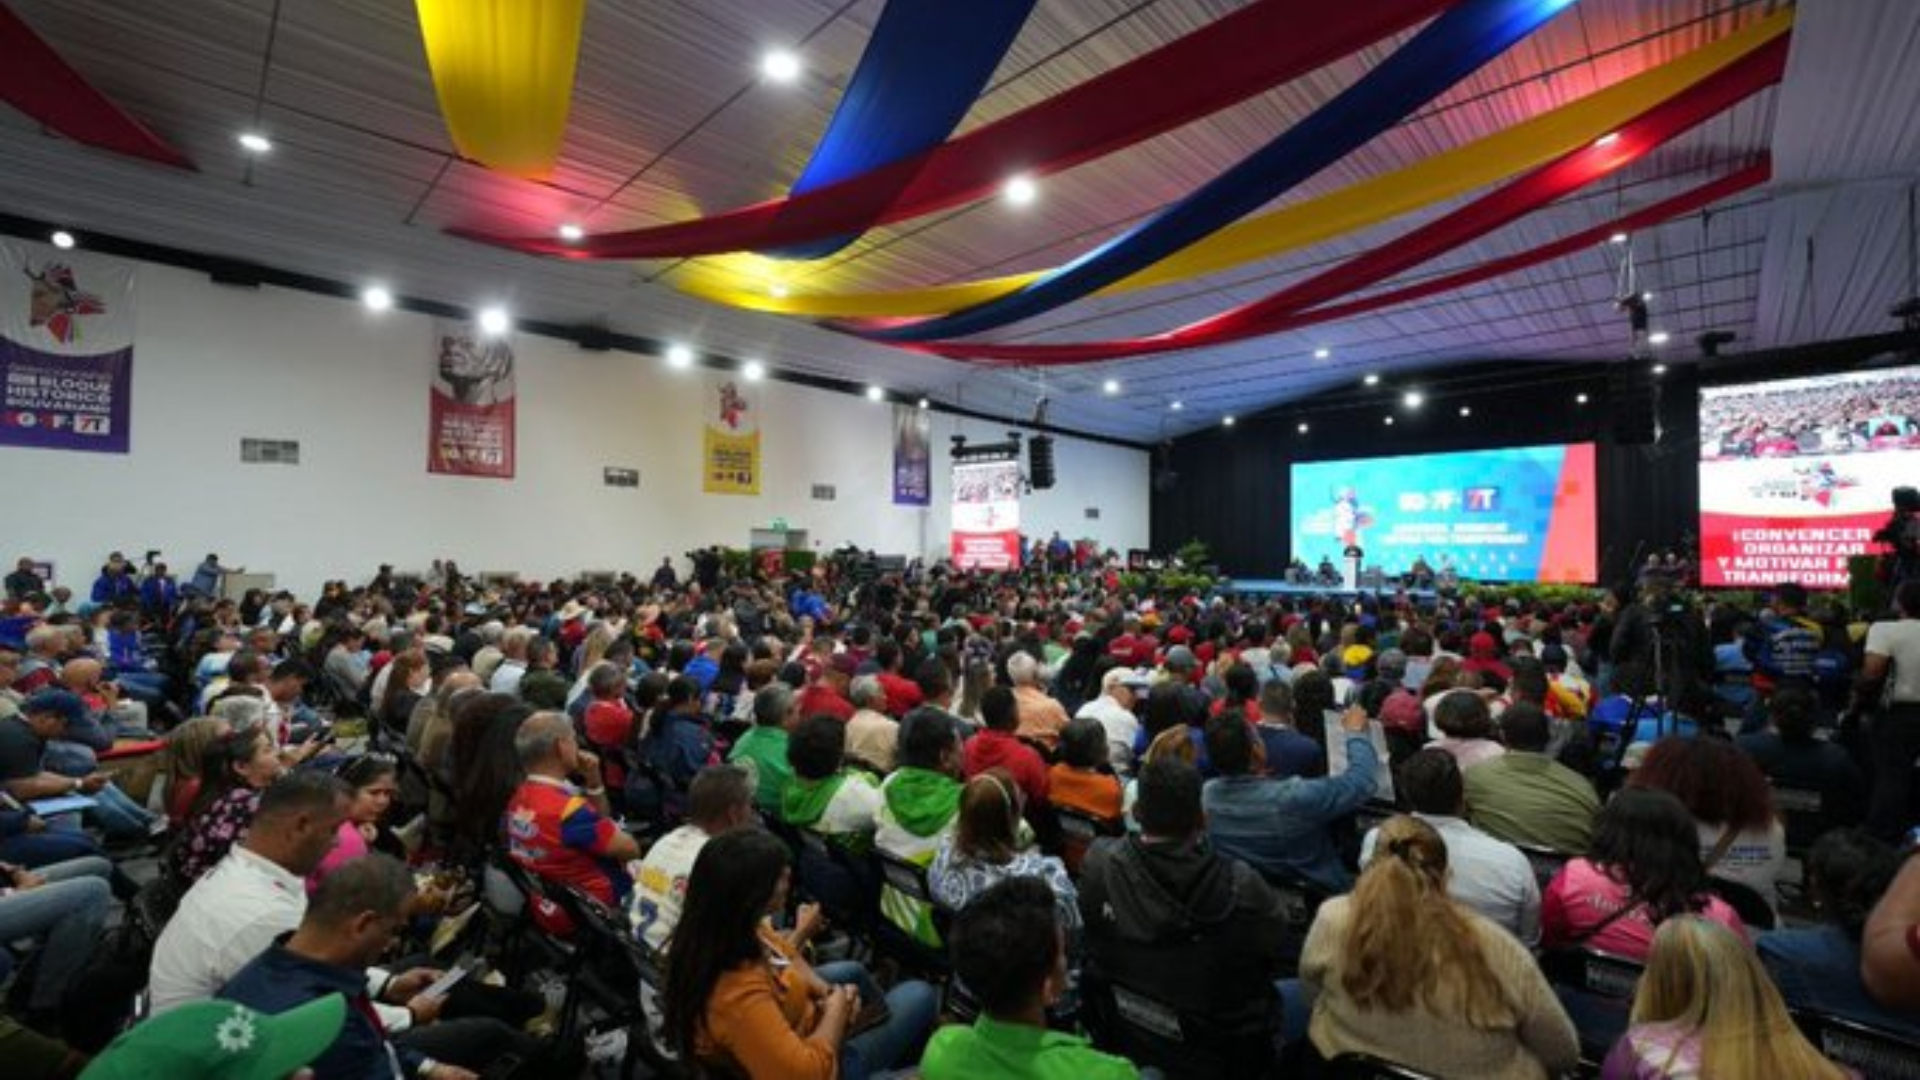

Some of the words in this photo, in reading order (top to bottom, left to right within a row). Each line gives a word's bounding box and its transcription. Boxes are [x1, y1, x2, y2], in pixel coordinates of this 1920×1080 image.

[1744, 542, 1864, 555] ORGANIZAR
[1717, 556, 1731, 570] Y
[1734, 555, 1828, 569] MOTIVAR
